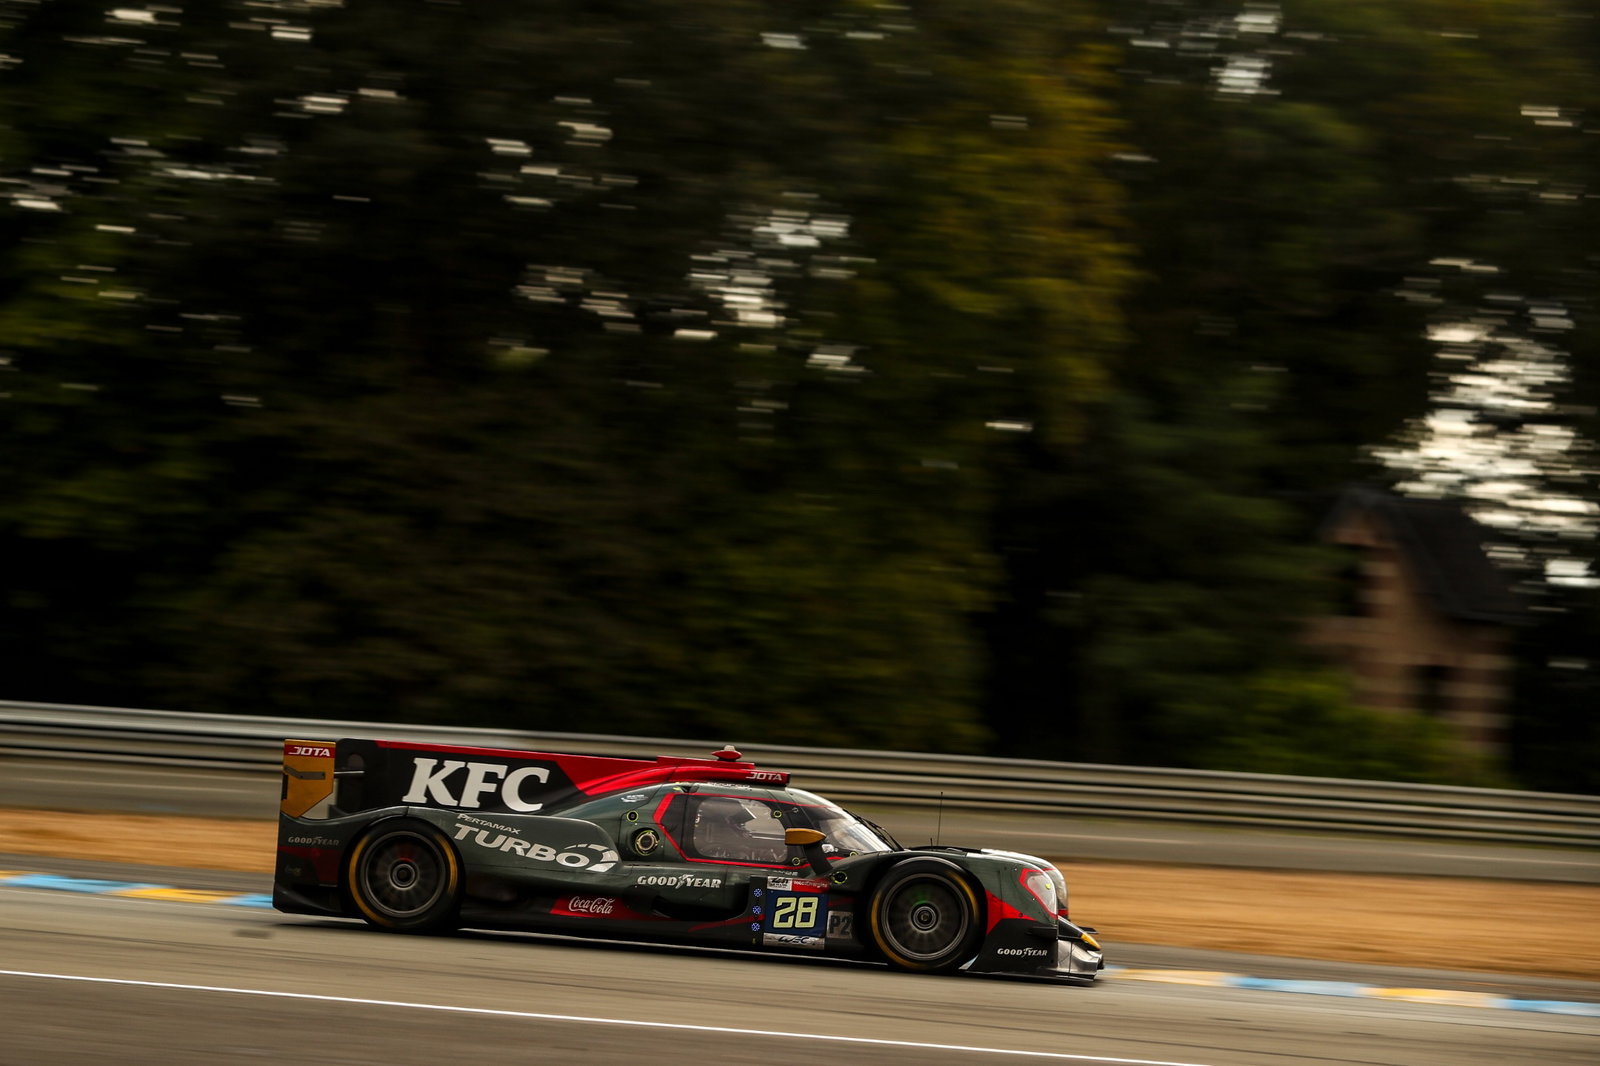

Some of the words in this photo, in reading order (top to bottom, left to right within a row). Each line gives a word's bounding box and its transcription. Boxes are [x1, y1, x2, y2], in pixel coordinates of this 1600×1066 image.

[288, 746, 331, 757] JOTA
[401, 757, 550, 812] KFC
[745, 772, 783, 781] JOTA
[456, 813, 521, 835] PERTAMAX
[453, 823, 590, 868] TURBO
[773, 896, 819, 929] 28
[829, 915, 852, 935] P2
